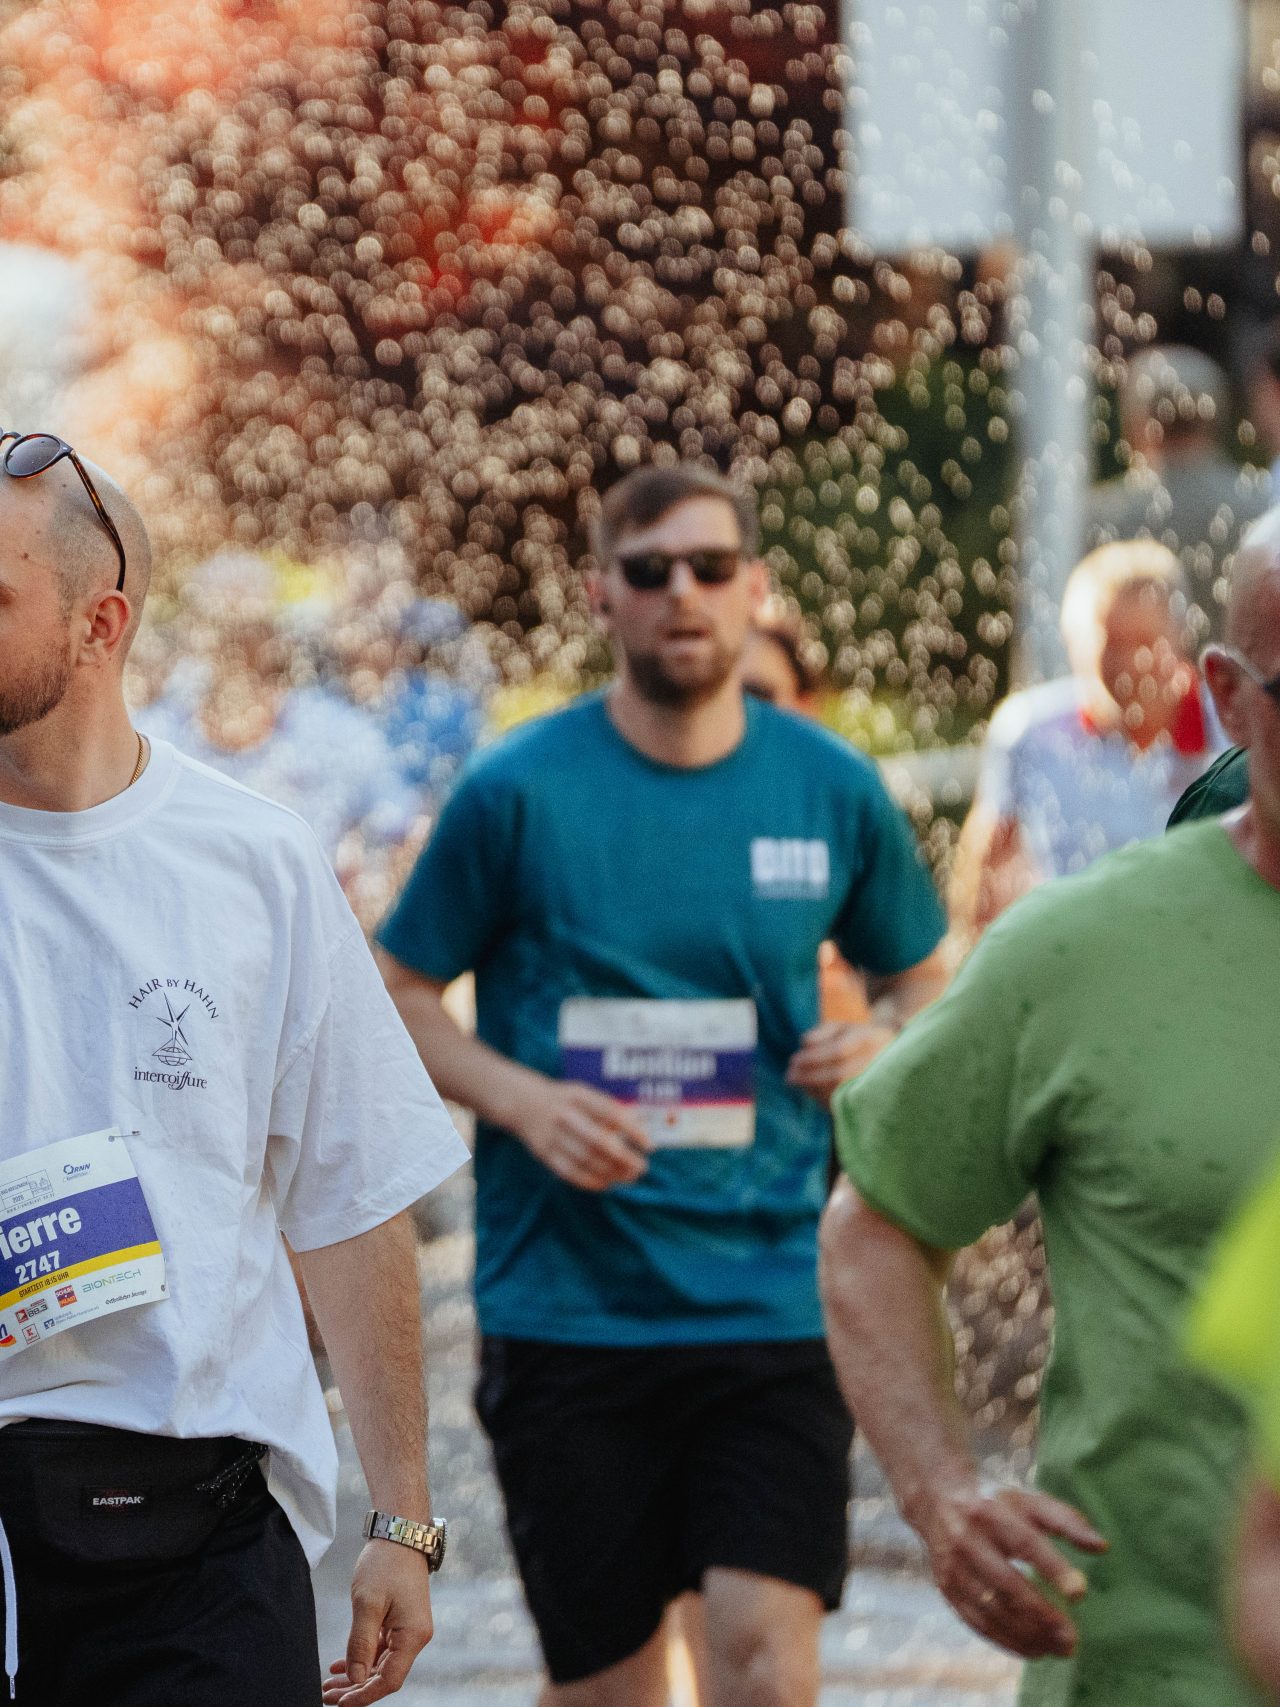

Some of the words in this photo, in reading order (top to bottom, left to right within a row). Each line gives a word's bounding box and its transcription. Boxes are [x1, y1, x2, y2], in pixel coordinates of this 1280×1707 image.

[128, 978, 163, 1009] HAIR
[166, 979, 180, 988] BY
[184, 979, 219, 1019] HAHN
[133, 1066, 208, 1091] intercoiffure
[14, 1250, 61, 1285] 2747
[18, 1281, 44, 1298] STARTZEIT
[57, 1271, 70, 1281] UHR
[82, 1268, 142, 1293] BIONTECH
[27, 1304, 48, 1318] 88.3
[92, 1496, 142, 1506] EASTPAK
